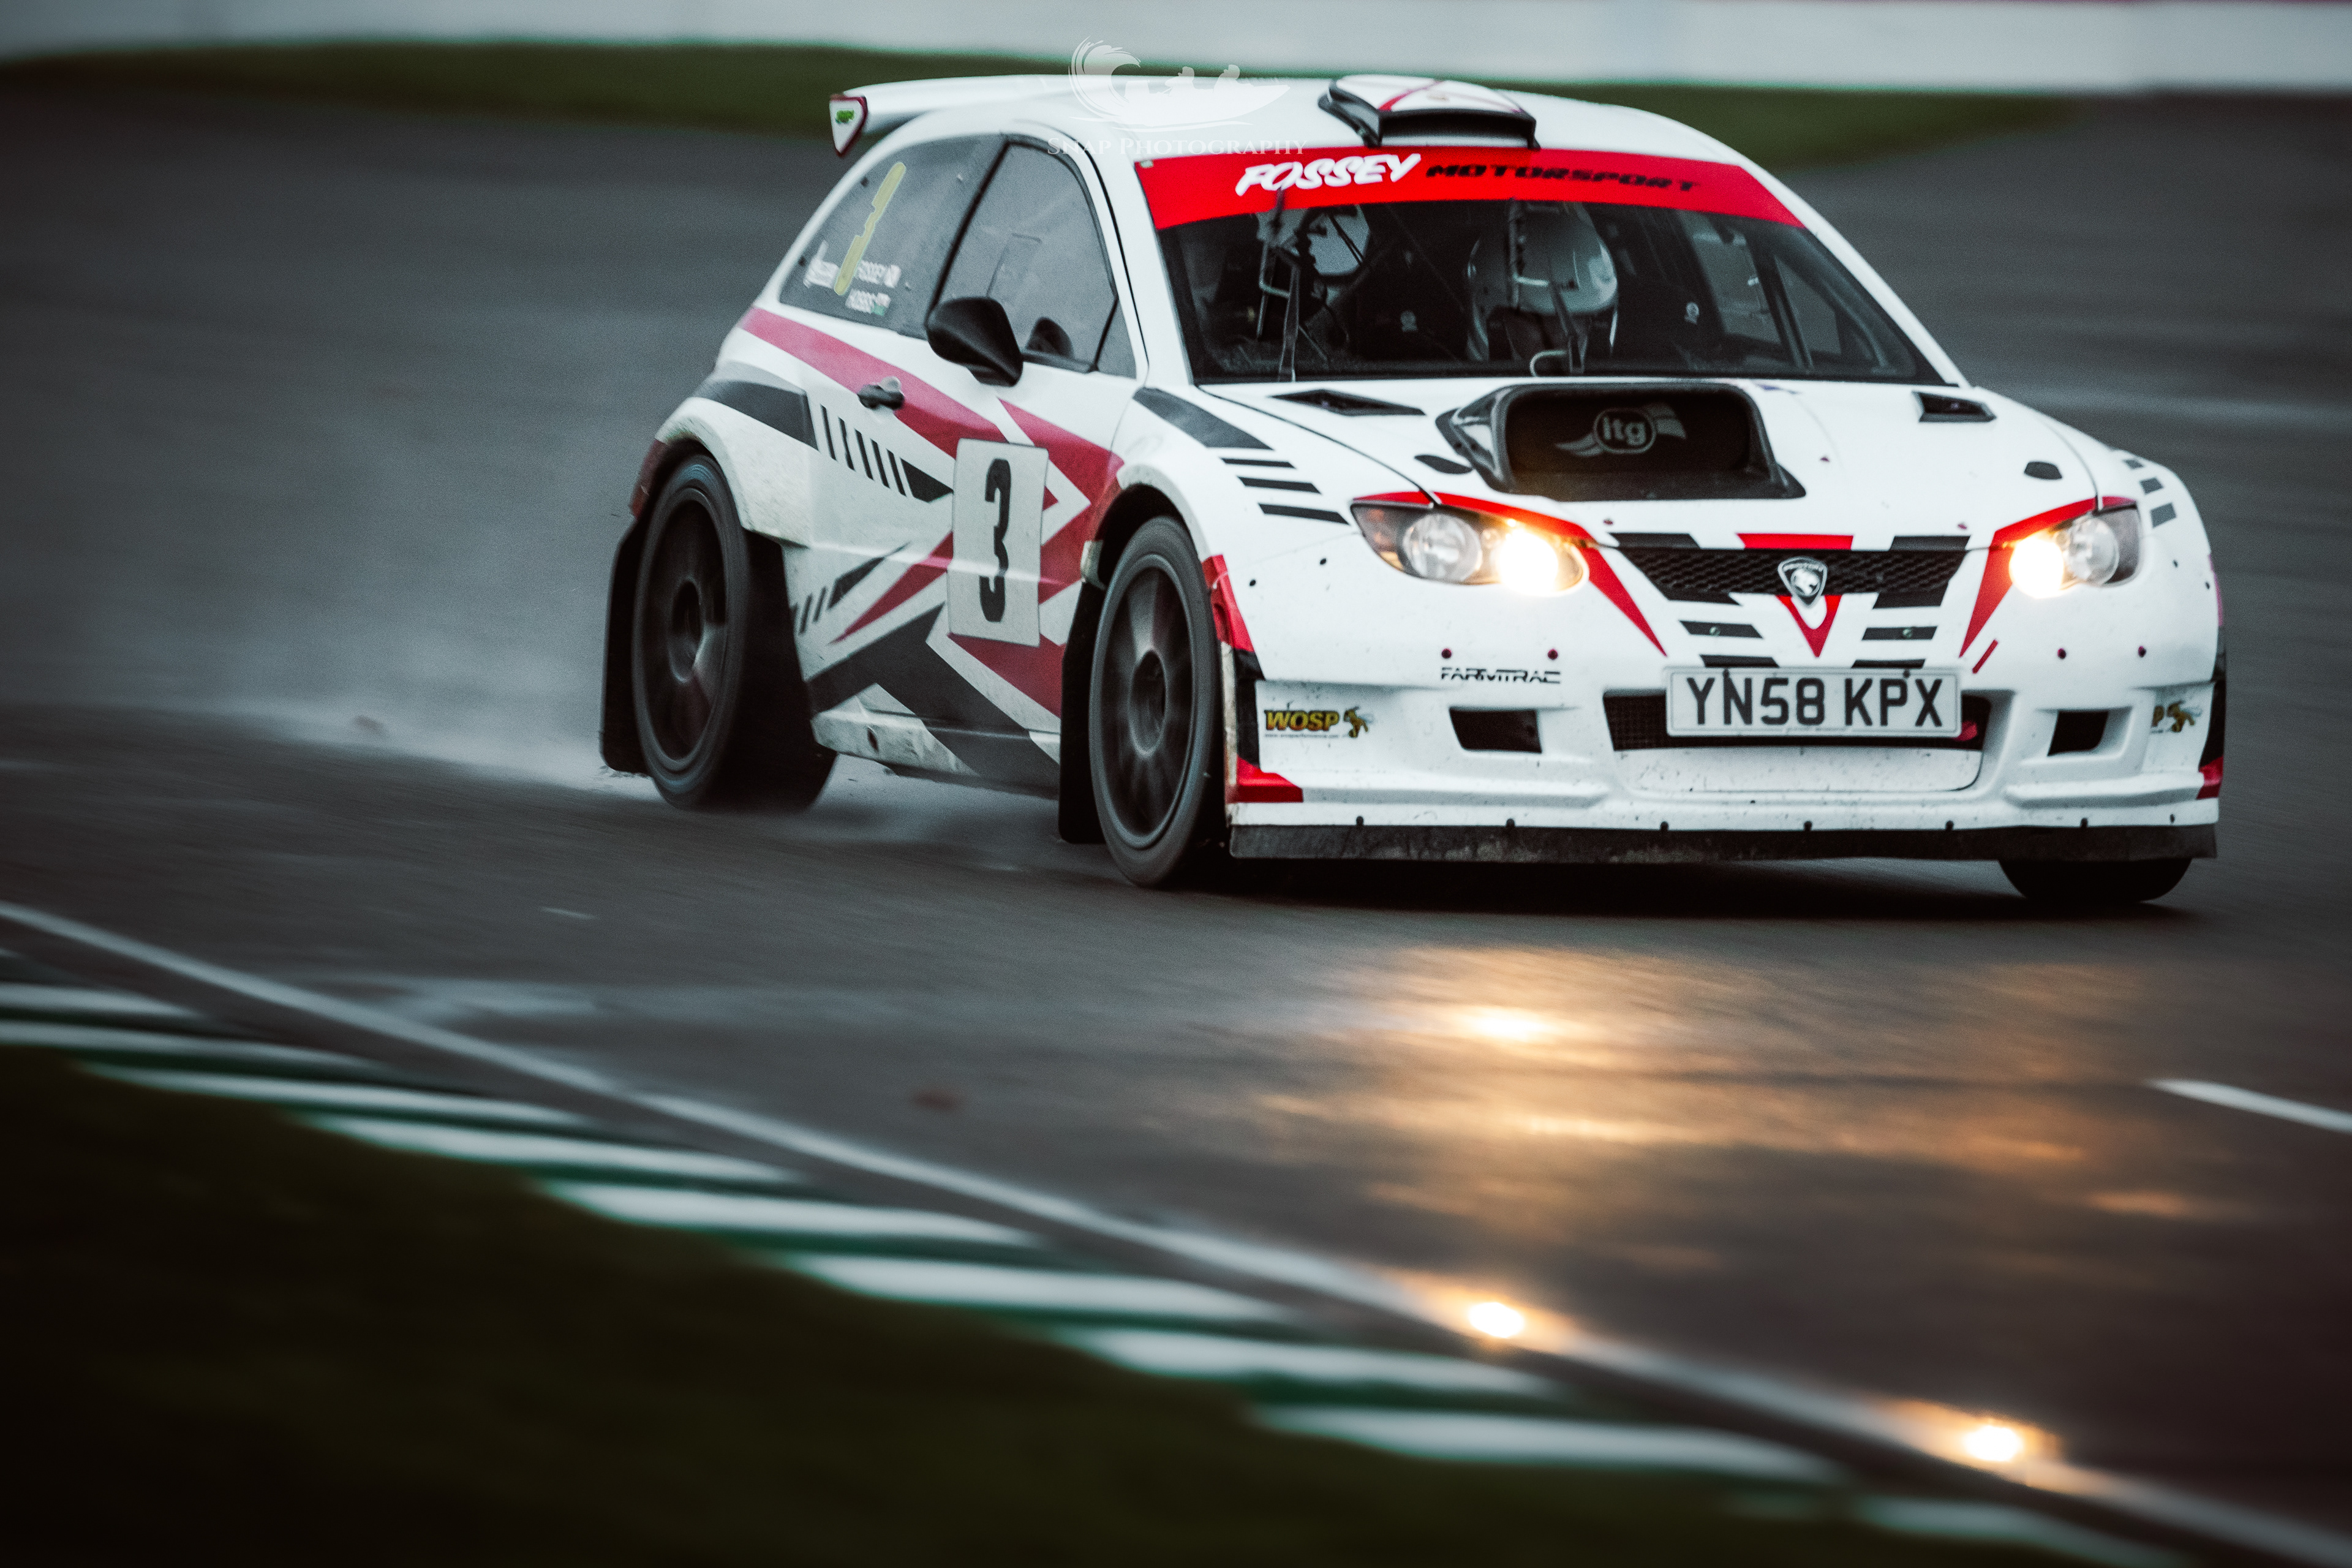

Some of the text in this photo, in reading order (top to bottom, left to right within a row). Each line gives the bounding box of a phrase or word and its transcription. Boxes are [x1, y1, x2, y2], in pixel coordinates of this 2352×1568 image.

[1235, 153, 1701, 197] FOSSEY MOTORSPORT
[979, 458, 1011, 623] 3
[1264, 709, 1340, 732] WOSP
[1686, 677, 1943, 728] YN58 KPX
